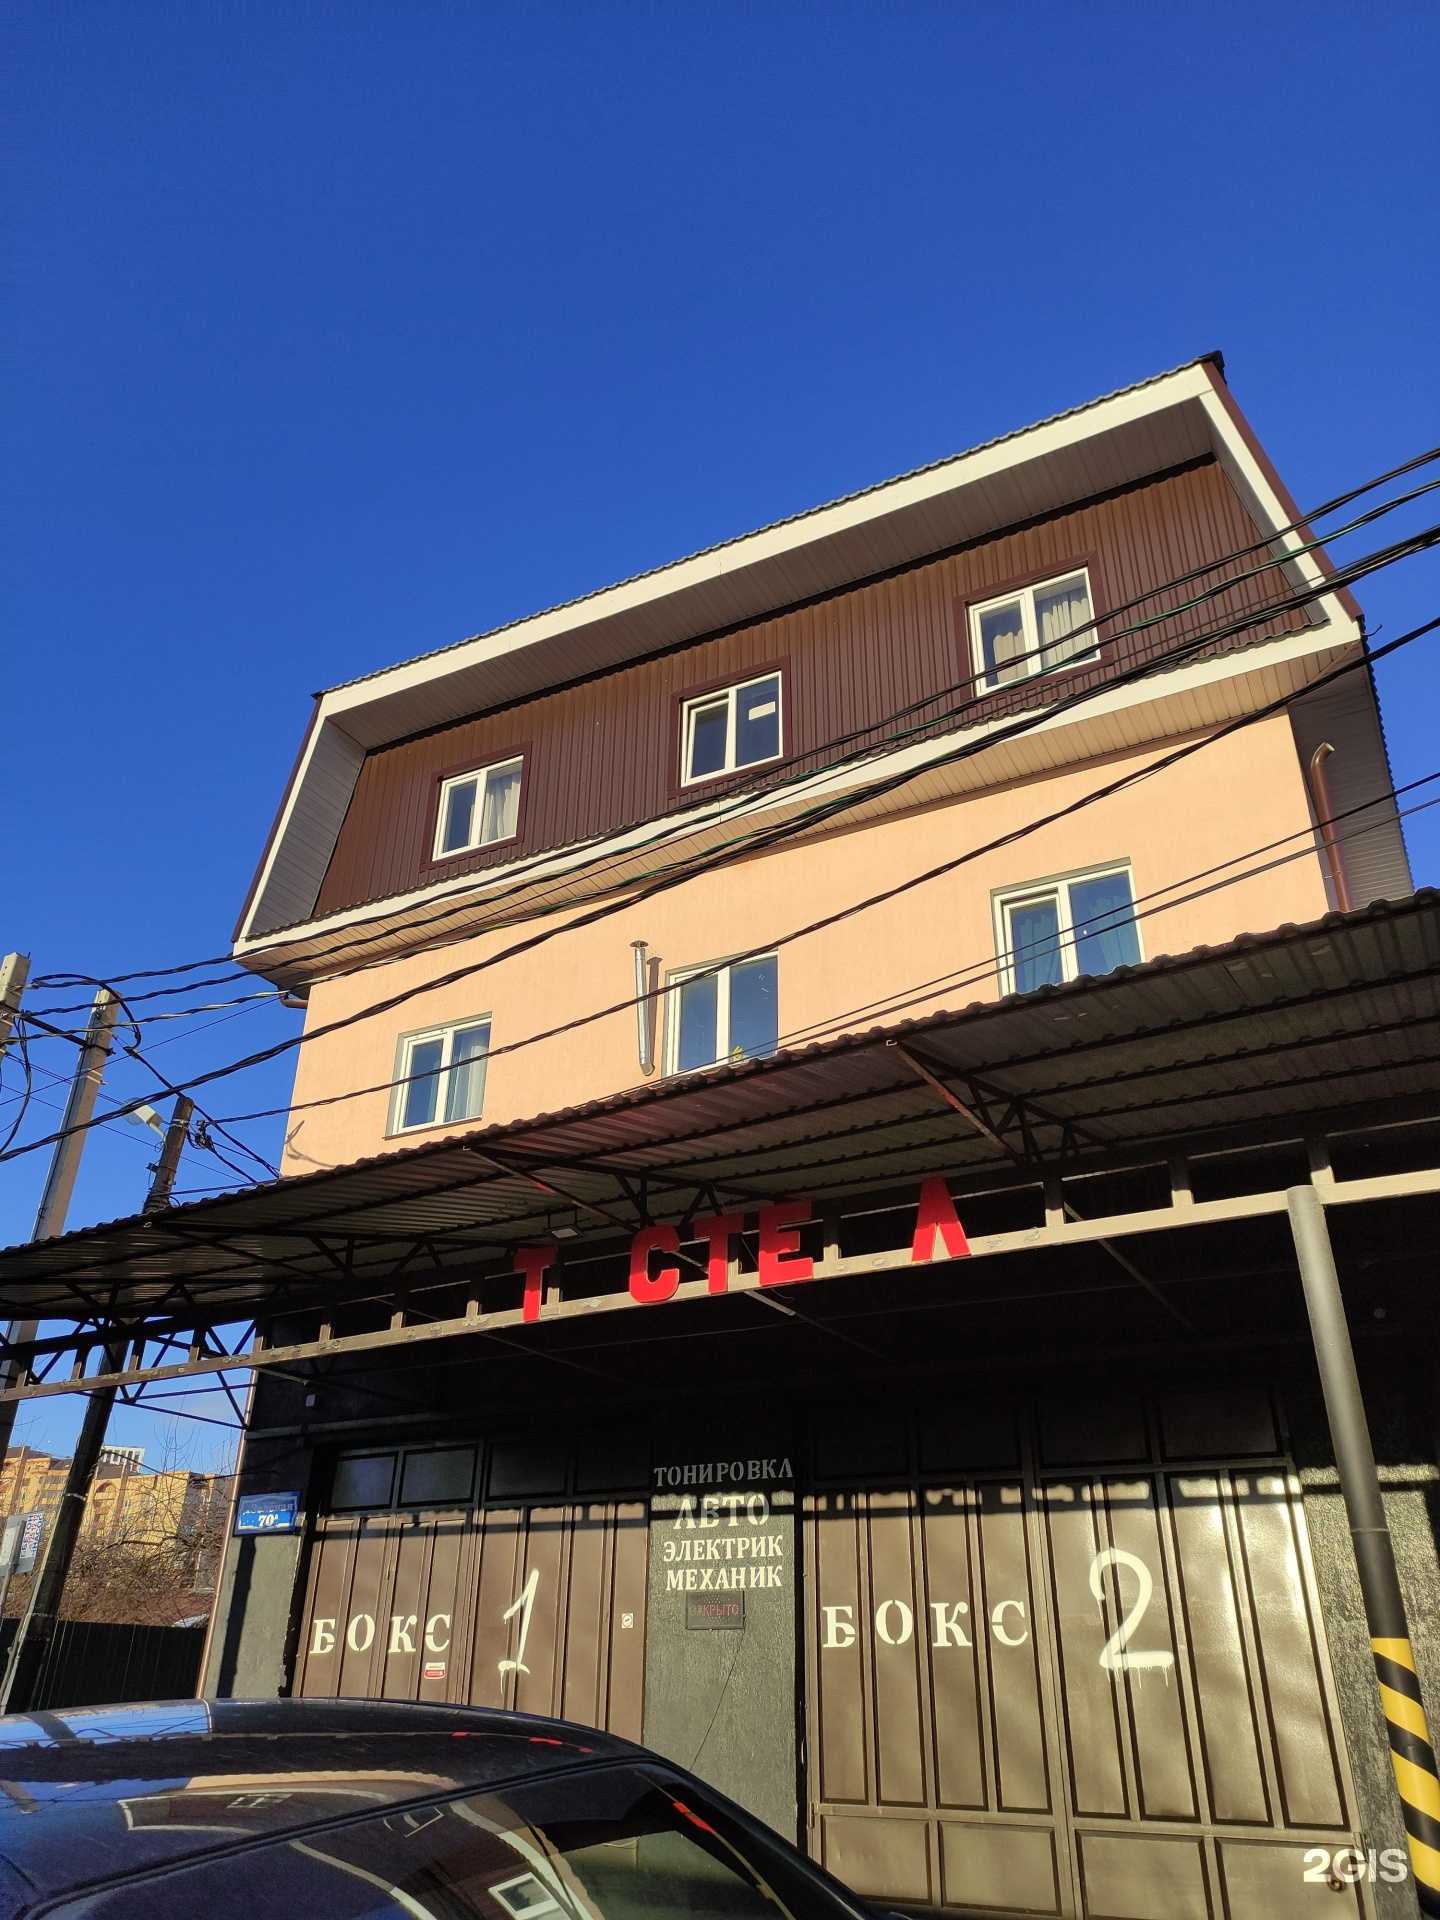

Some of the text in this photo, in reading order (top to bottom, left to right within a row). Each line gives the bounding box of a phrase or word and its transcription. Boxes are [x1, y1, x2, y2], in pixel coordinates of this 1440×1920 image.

[653, 1458, 793, 1487] ТОНИРОВКА
[673, 1493, 770, 1530] АВТО
[663, 1535, 784, 1562] ЭЛЕКТРИК
[665, 1565, 783, 1591] МЕХАНИК
[309, 1567, 540, 1676] БОКС 1
[822, 1547, 1175, 1670] БОКС 2
